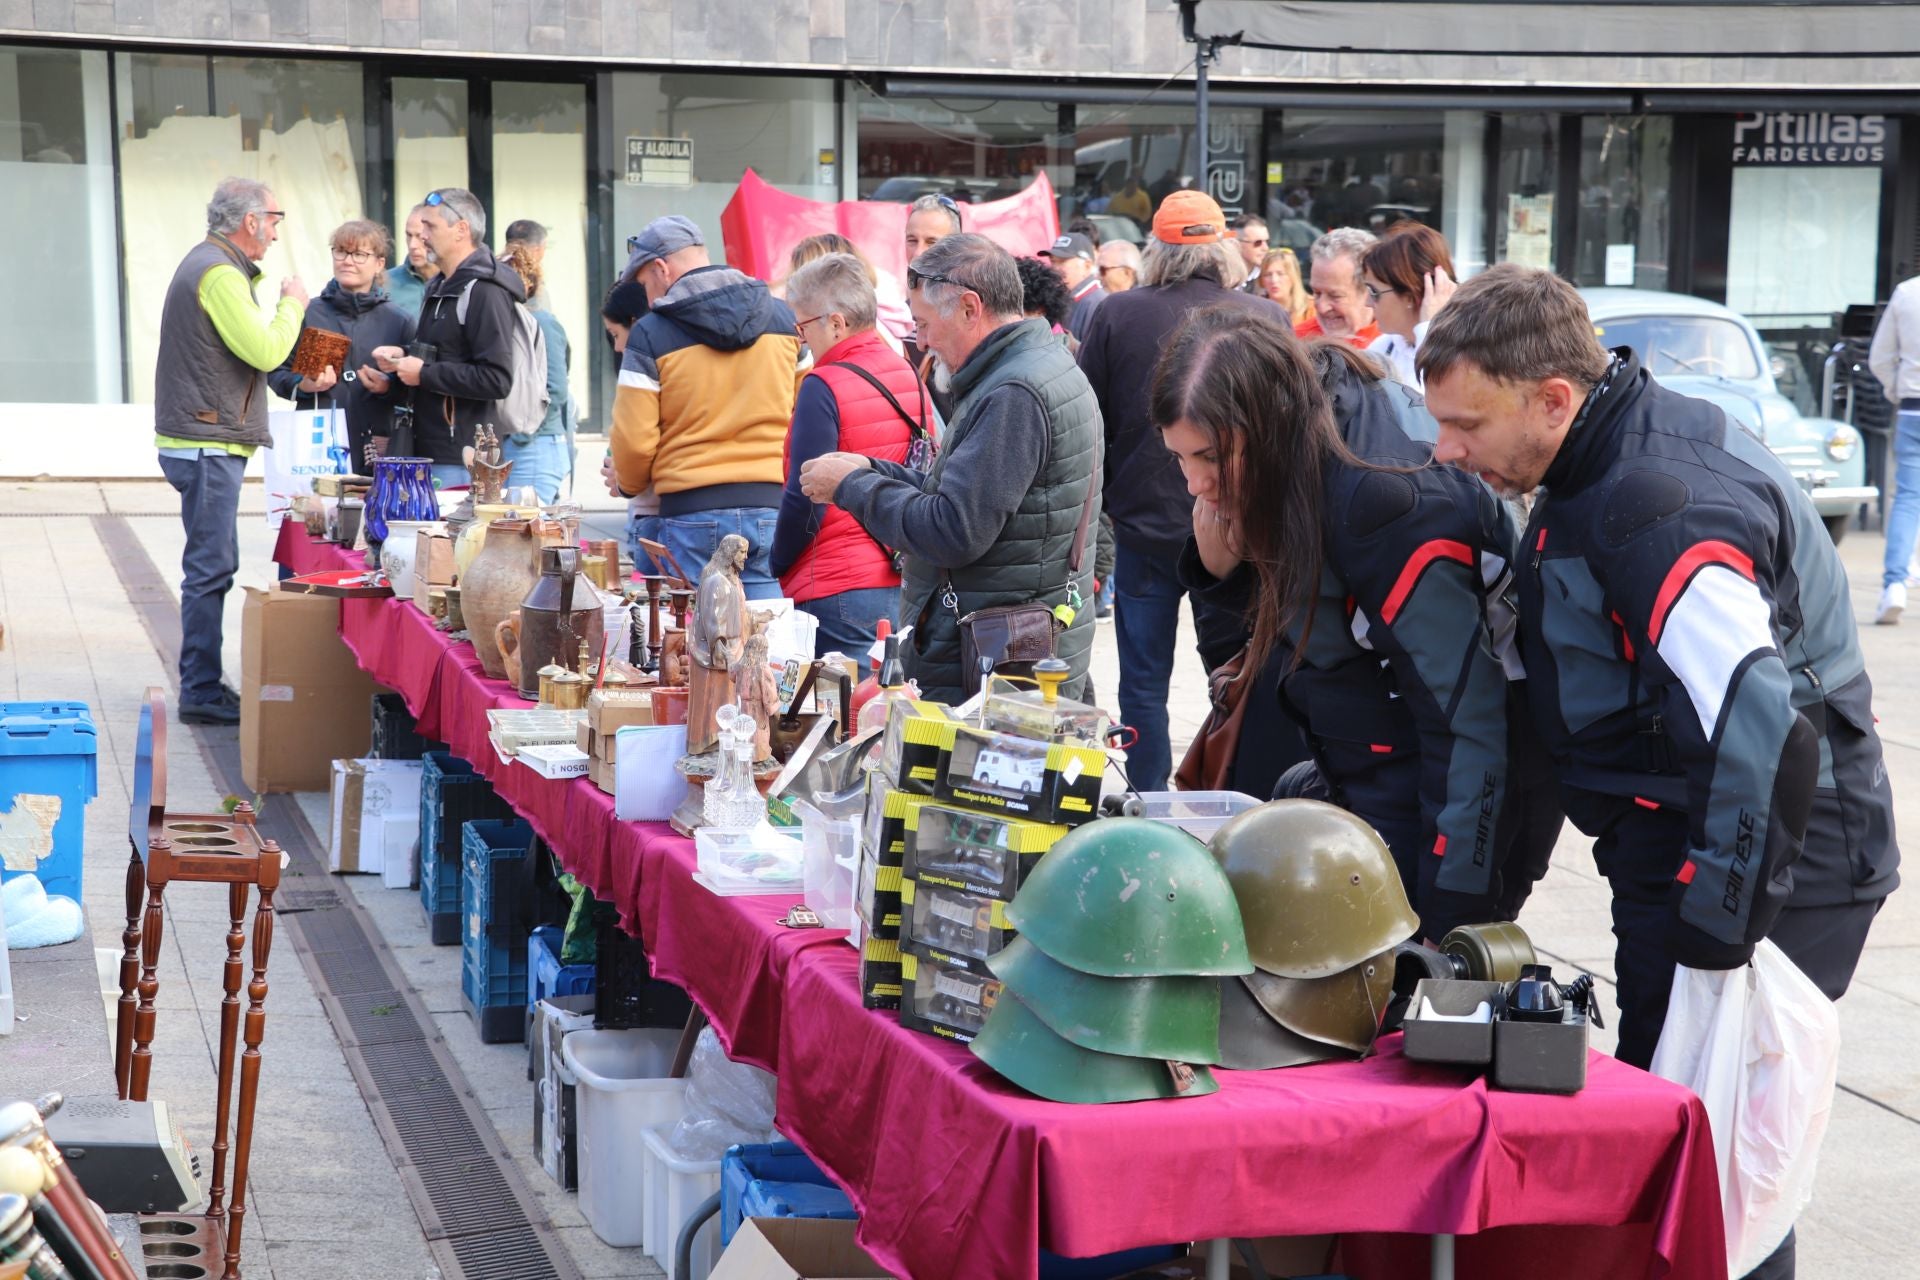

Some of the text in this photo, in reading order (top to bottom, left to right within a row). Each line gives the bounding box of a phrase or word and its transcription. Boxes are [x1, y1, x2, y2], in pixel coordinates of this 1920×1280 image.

[1734, 112, 1885, 144] Pitillas
[630, 141, 690, 157] SE ALQUILA
[1732, 146, 1885, 162] FARDELEJOS
[560, 764, 590, 772] IDSON
[1007, 801, 1028, 810] SCANIA
[1473, 770, 1496, 868] DAINESE
[1722, 807, 1754, 917] DAINESE
[919, 873, 1000, 896] Transporte Forestal Mercedes-Benz
